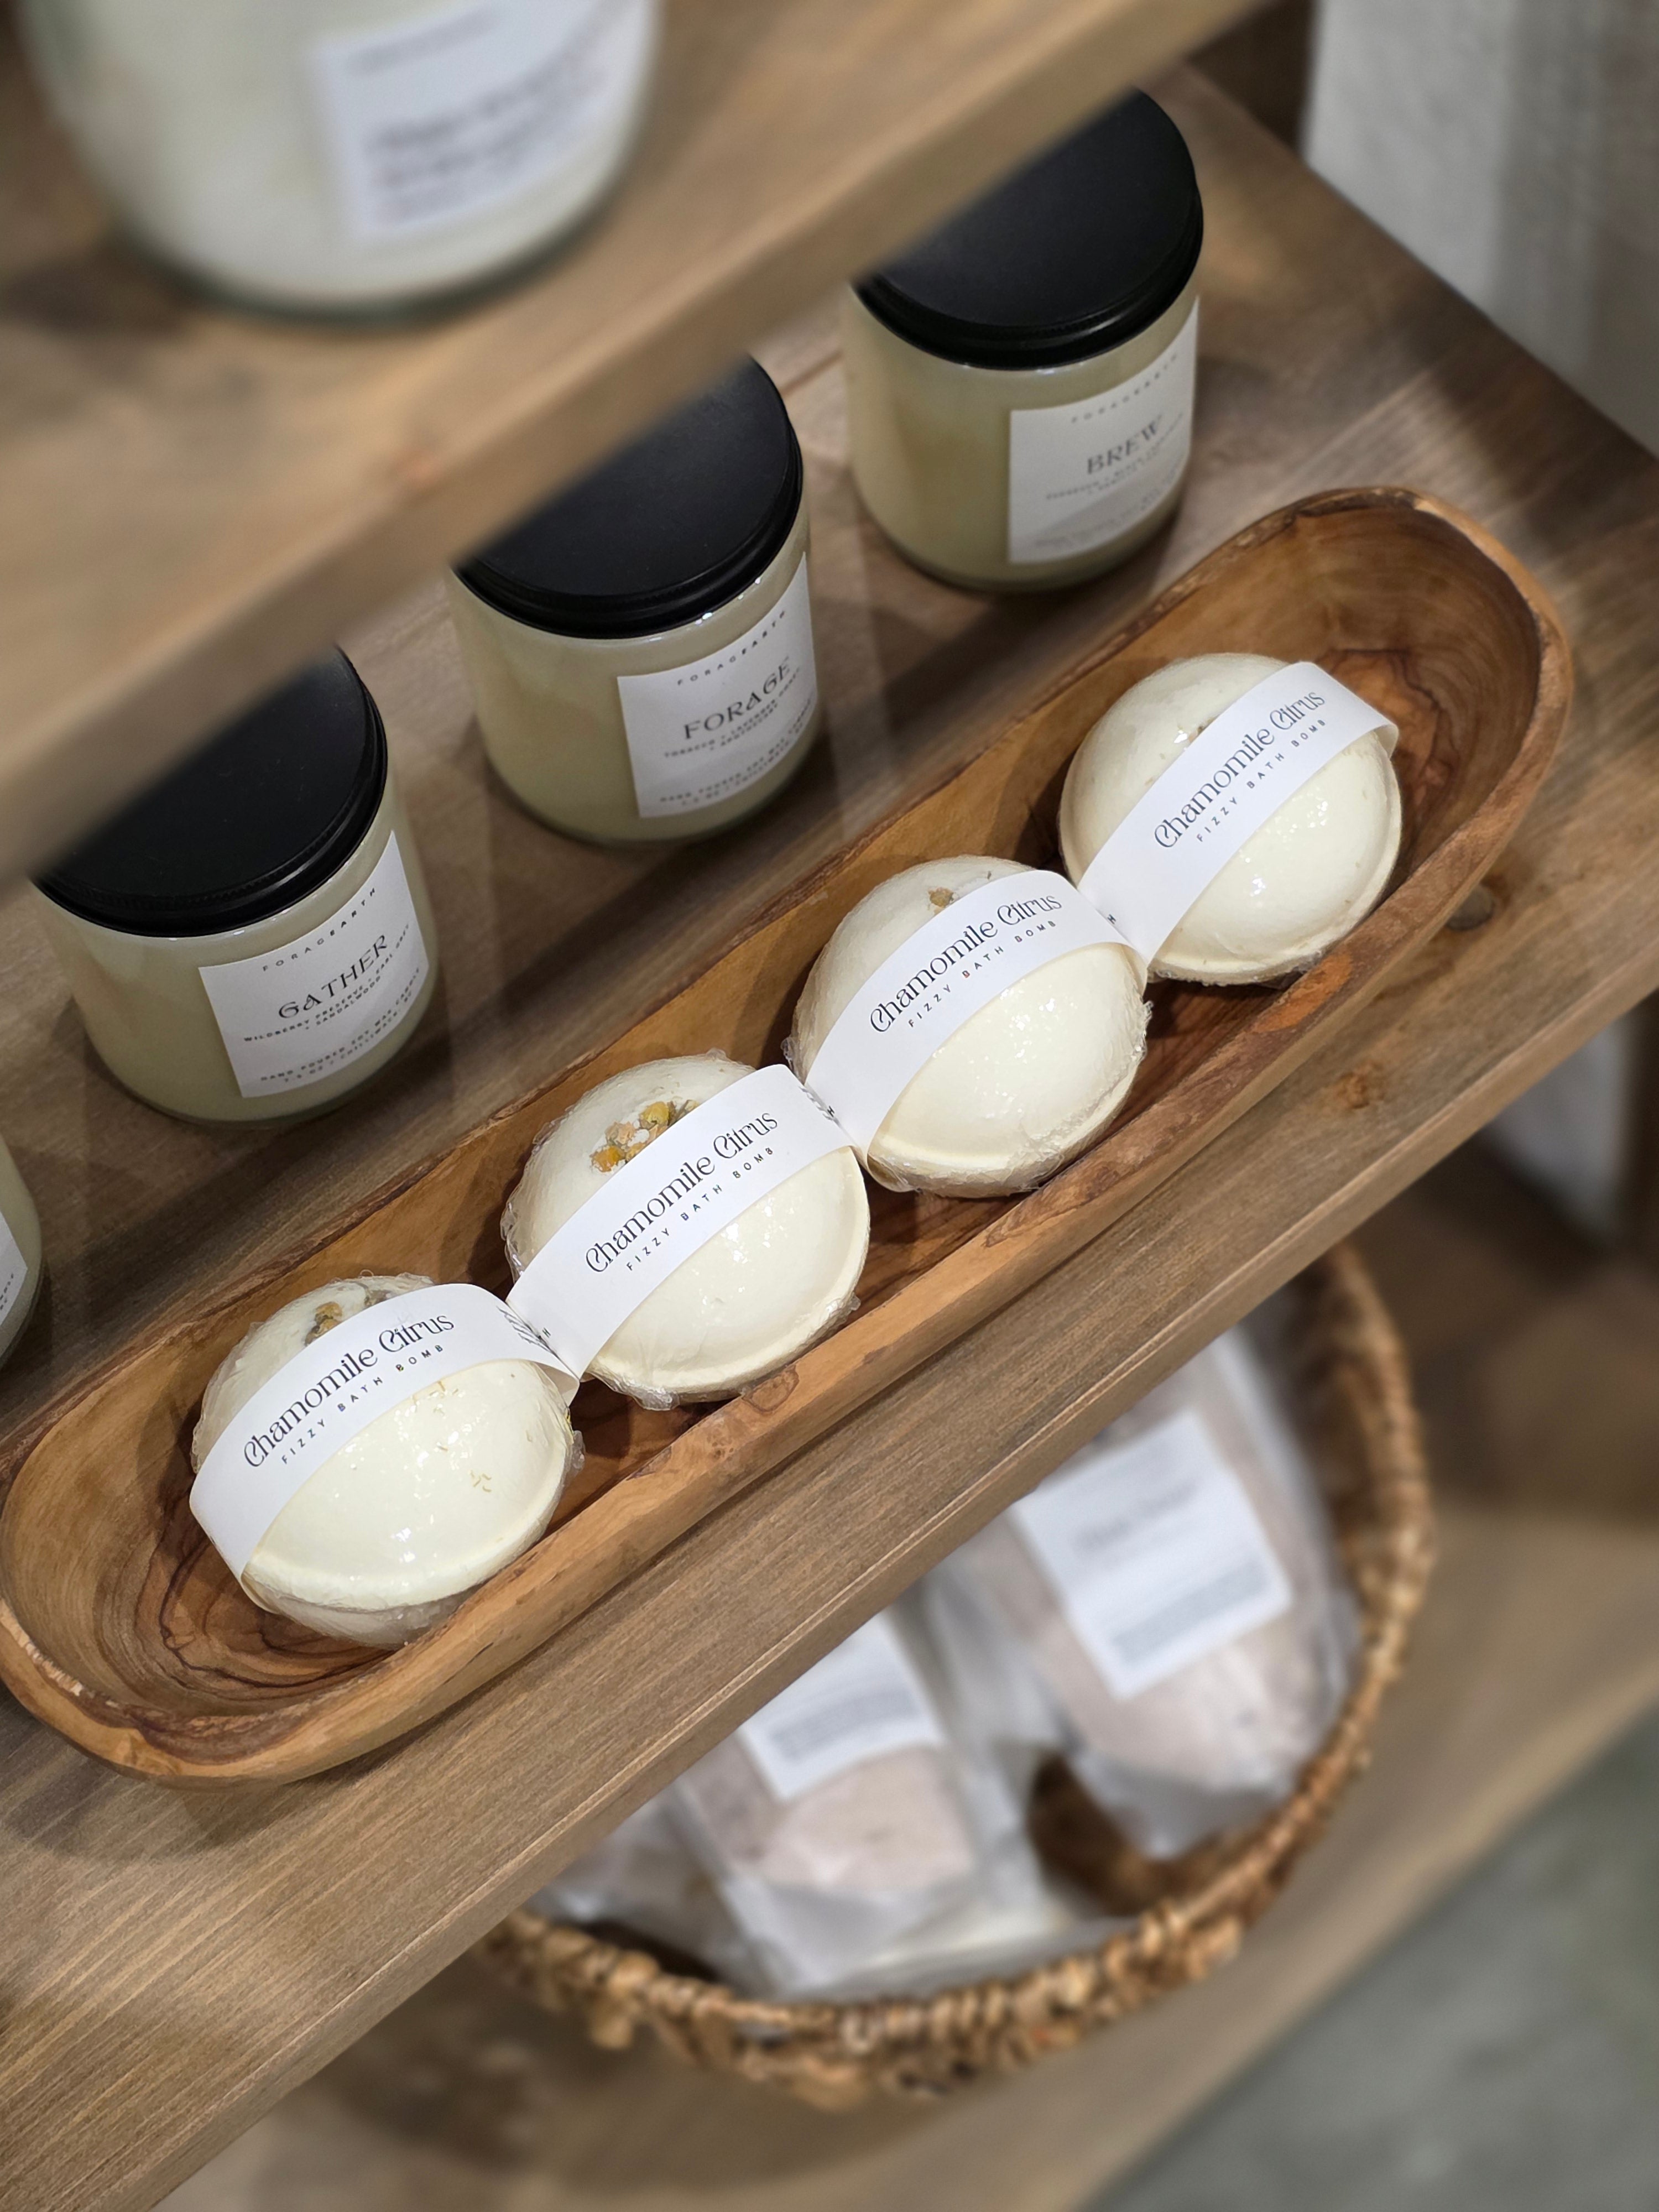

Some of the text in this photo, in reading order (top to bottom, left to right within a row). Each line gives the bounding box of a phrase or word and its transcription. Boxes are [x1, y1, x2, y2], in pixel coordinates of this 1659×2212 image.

[1087, 414, 1162, 475] BREW
[683, 655, 790, 740] FORAGE
[1154, 692, 1326, 848] Chamomile Citrus
[1196, 719, 1326, 842] FIZZY BATH BOMB
[278, 934, 388, 1019] GATHER
[870, 895, 1062, 1032] Chamomile Citrus
[907, 920, 1056, 1028] FIZZY BATH BOMB
[243, 1019, 310, 1042] WILDBERRY
[585, 1113, 778, 1272] Chamomile Citrus
[625, 1147, 773, 1271] FIZZY BATH BOMB
[243, 1315, 455, 1468] Chamomile Citrus
[281, 1344, 444, 1465] FIZZY BATH BOMB
